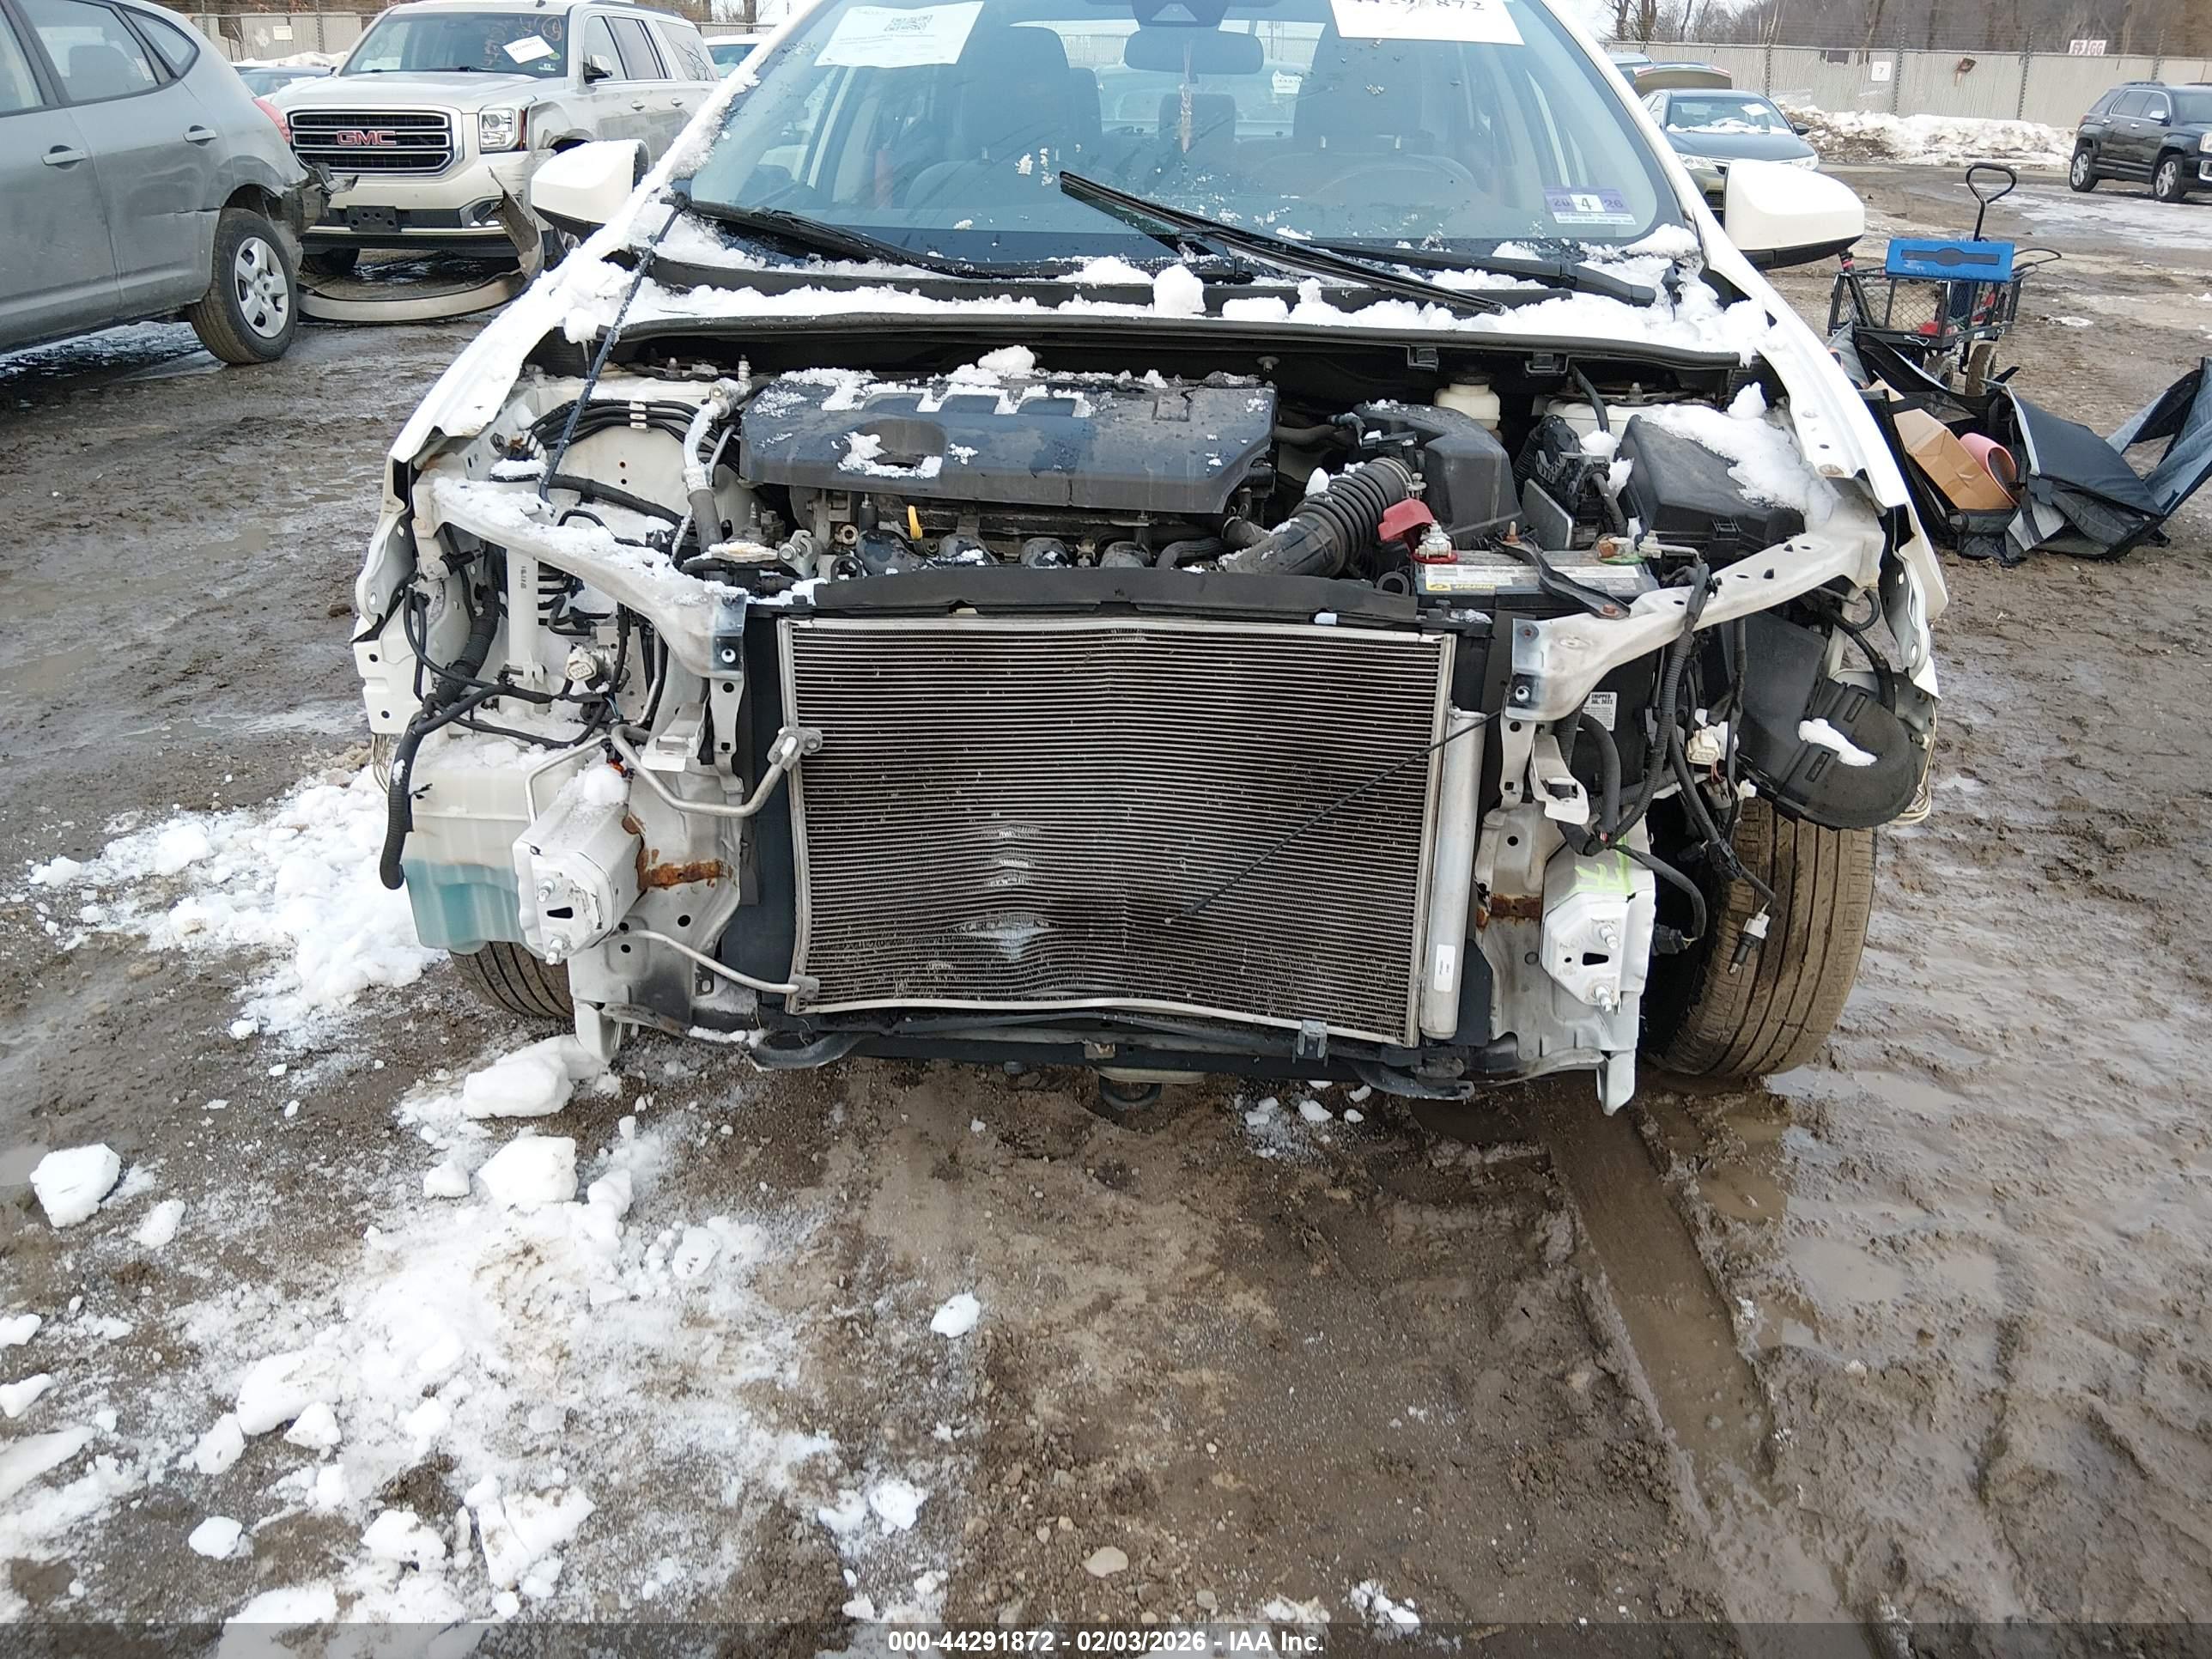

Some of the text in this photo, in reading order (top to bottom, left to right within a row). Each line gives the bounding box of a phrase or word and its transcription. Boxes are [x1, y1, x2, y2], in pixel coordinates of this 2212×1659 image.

[337, 130, 397, 146] GMC
[1552, 198, 1624, 210] 20 4 26
